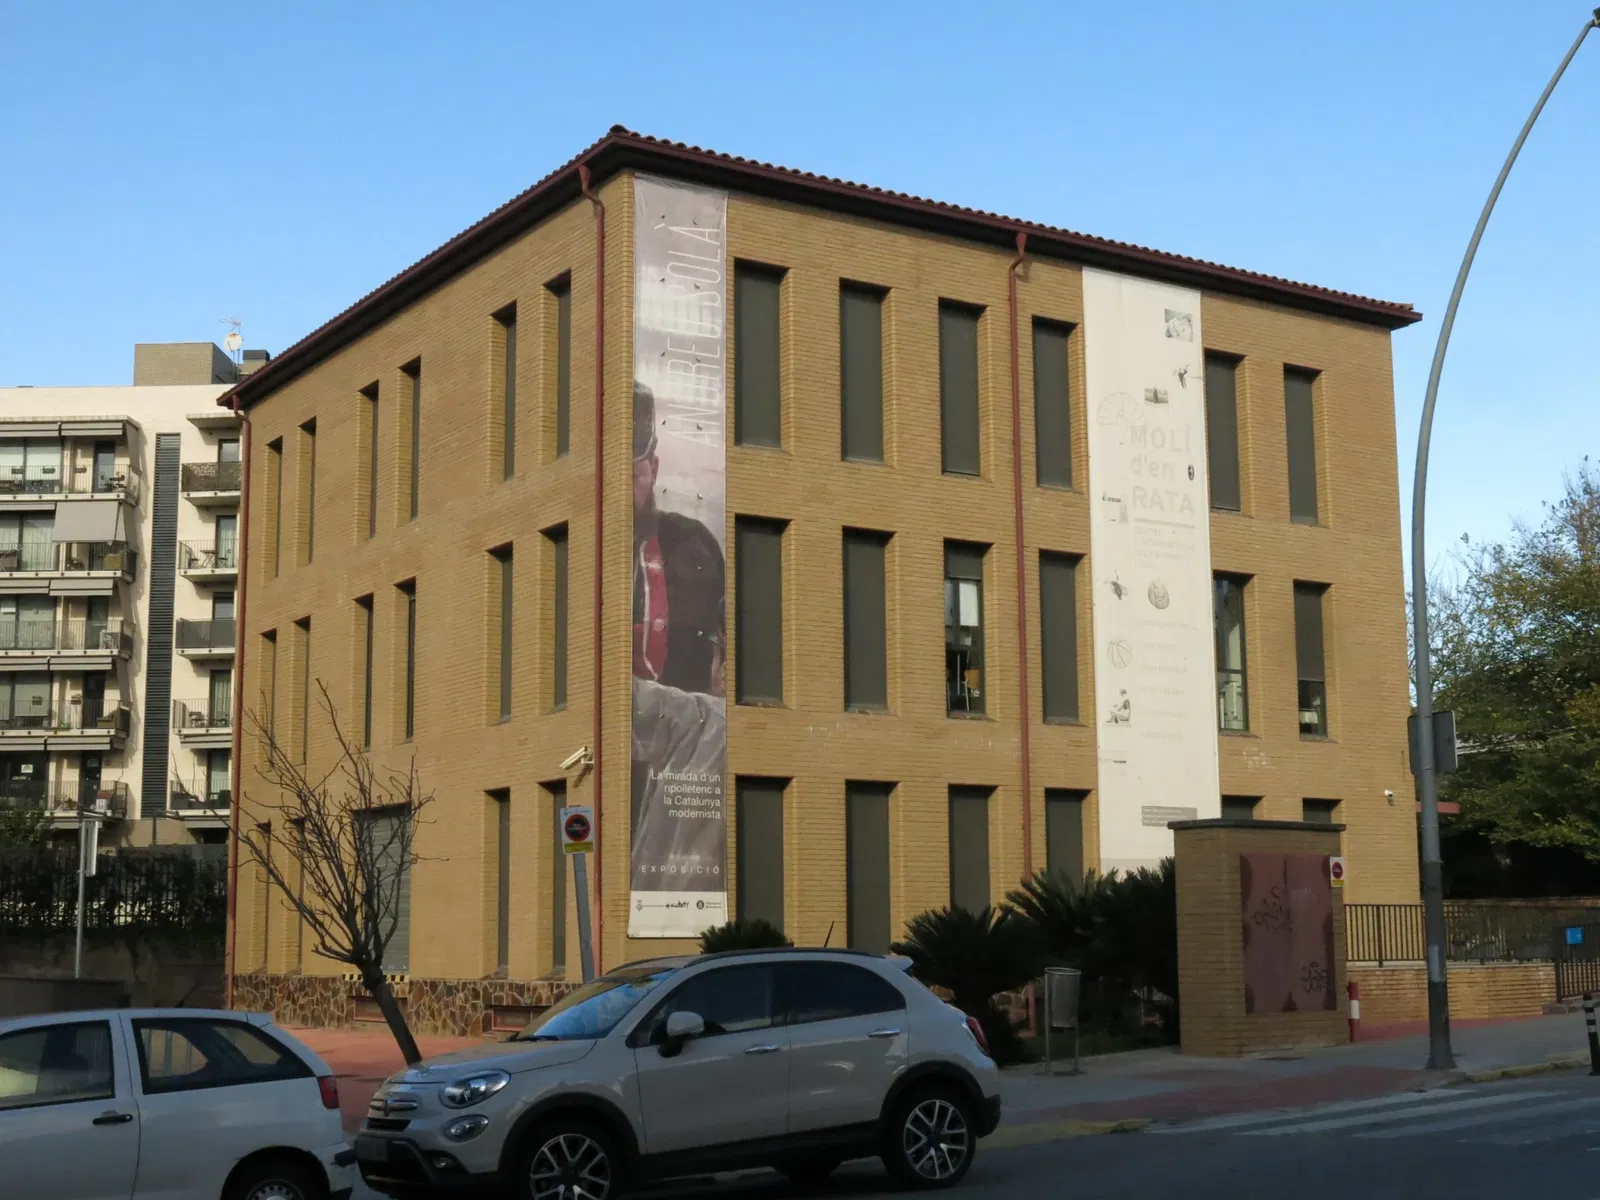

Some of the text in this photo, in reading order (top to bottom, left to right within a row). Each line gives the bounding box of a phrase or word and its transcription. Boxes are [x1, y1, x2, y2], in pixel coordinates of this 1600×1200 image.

[653, 222, 721, 448] ANDREU SOLÀ
[1130, 453, 1174, 480] d'en
[1132, 484, 1194, 516] RATA
[651, 768, 721, 782] La mirada d'un
[715, 786, 721, 794] a
[663, 795, 721, 808] la Catalunya
[668, 809, 721, 819] modernista
